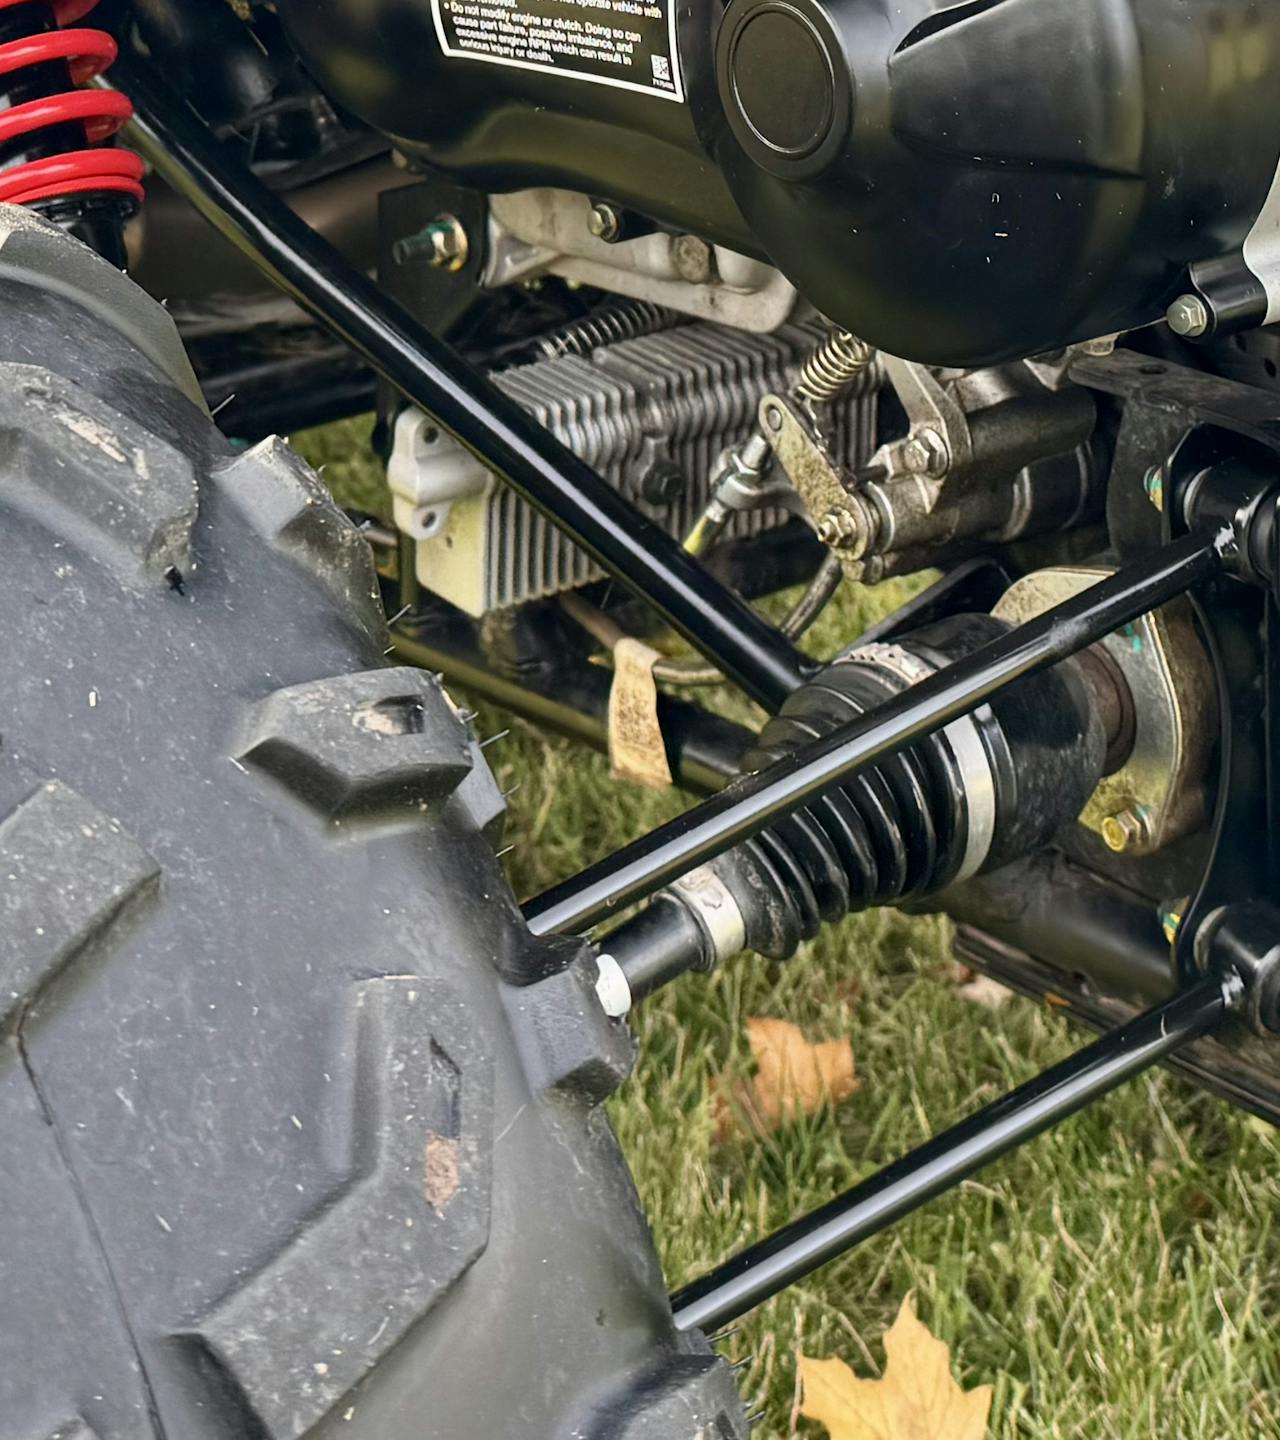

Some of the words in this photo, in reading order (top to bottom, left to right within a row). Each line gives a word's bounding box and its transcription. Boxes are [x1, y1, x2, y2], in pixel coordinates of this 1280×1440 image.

[450, 1, 464, 14] Do
[465, 6, 480, 16] not
[481, 8, 510, 23] modify
[511, 13, 541, 26] engine
[543, 18, 552, 27] or
[554, 18, 584, 32] clutch.
[585, 22, 611, 39] Doing
[613, 28, 624, 39] so
[625, 31, 641, 43] can
[612, 0, 642, 15] vehicle
[644, 6, 662, 18] with
[453, 15, 478, 27] cause
[480, 20, 498, 31] part
[499, 20, 528, 36] failure,
[529, 27, 566, 42] possible
[567, 32, 615, 51] imbalance,
[616, 42, 633, 53] and
[455, 27, 497, 41] excessive
[498, 34, 527, 47] engine
[528, 37, 551, 51] RPM
[552, 42, 578, 55] which
[580, 47, 597, 59] can
[598, 50, 622, 64] result
[623, 54, 632, 66] in
[515, 49, 525, 57] or
